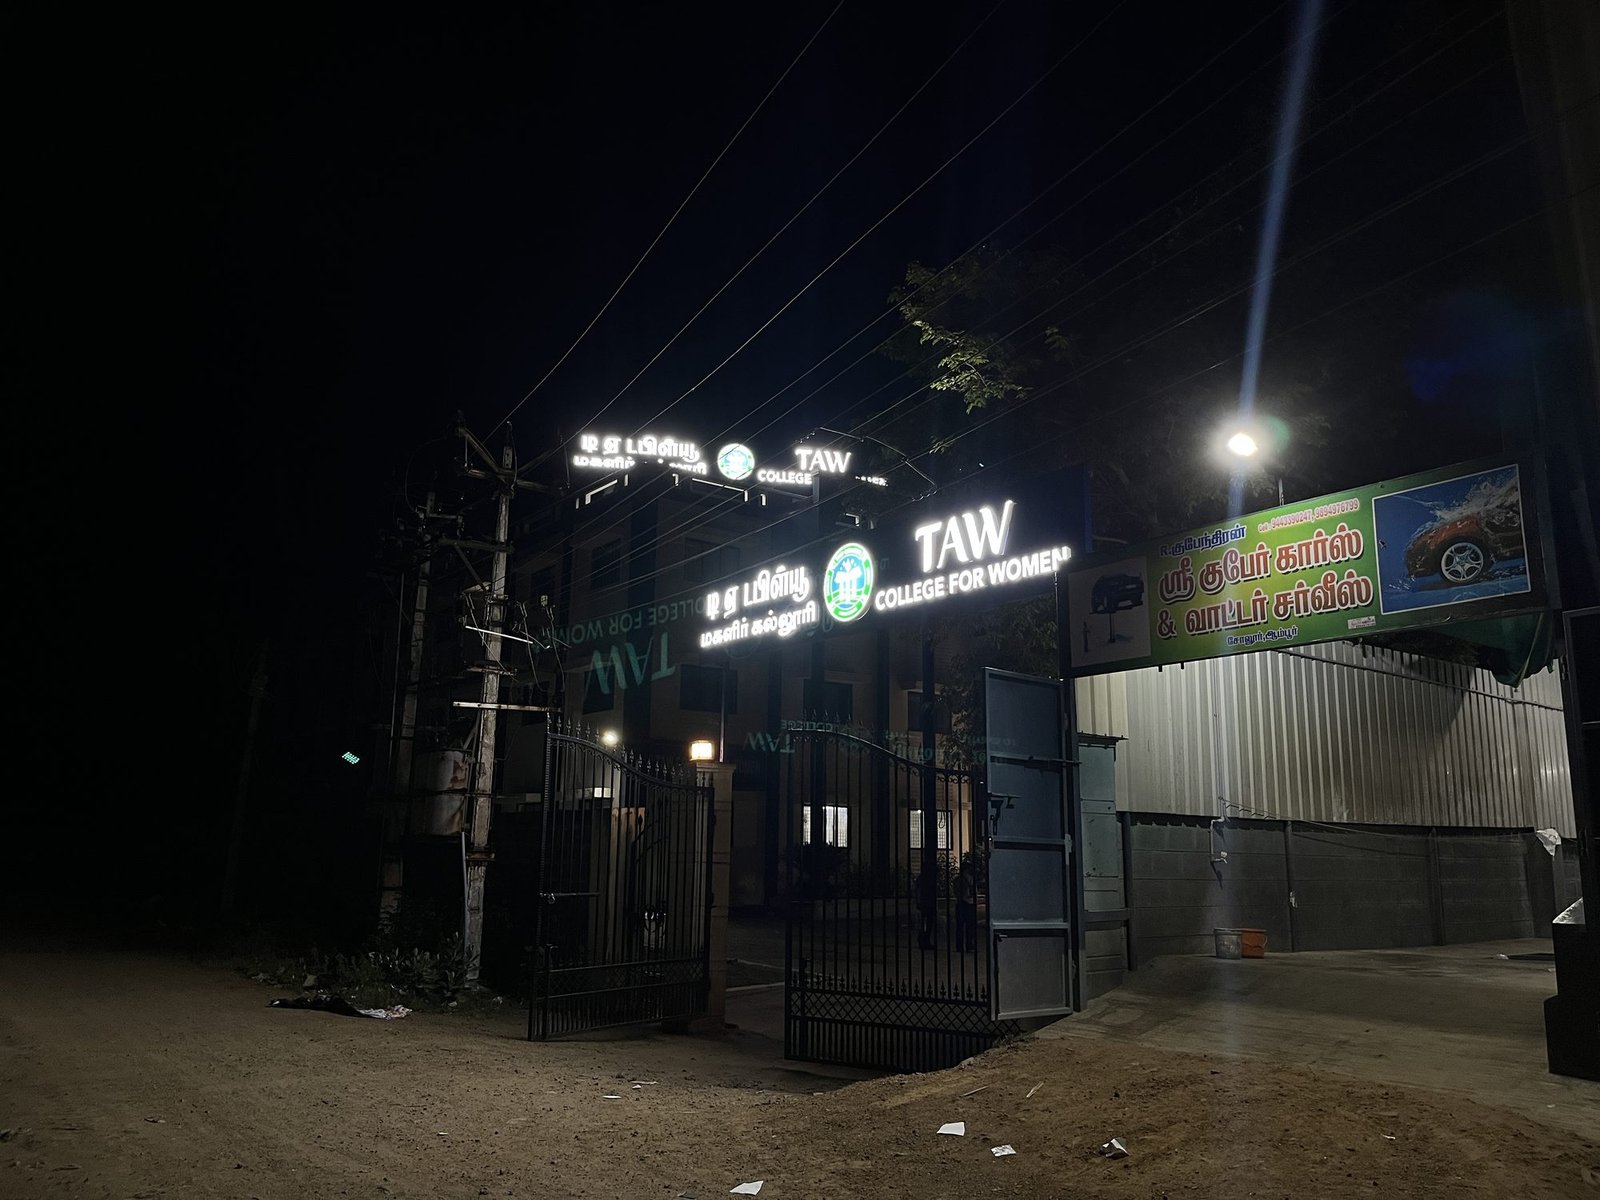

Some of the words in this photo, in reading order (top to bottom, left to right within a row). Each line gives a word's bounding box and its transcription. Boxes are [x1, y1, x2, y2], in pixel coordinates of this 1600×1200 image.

[581, 434, 598, 453] டி
[602, 437, 622, 455] ஏ
[795, 448, 852, 474] TAW
[757, 469, 813, 485] COLLEGE
[915, 499, 1014, 573] TAW
[1159, 556, 1195, 603] ஸ்ரீ
[1198, 542, 1270, 594] குபேர்
[1275, 523, 1364, 572] கார்ஸ்
[706, 591, 720, 621] டி
[724, 585, 739, 619] ஏ
[874, 576, 945, 611] COLLEGE
[948, 566, 985, 594] FOR
[987, 546, 1072, 585] WOMEN
[1157, 609, 1176, 637] &
[1185, 588, 1269, 634] வாட்டர்
[1273, 569, 1374, 620] சர்வீஸ்
[700, 617, 749, 648] மகளிர்
[751, 600, 816, 636] கல்லூரி
[583, 632, 676, 701] TAW
